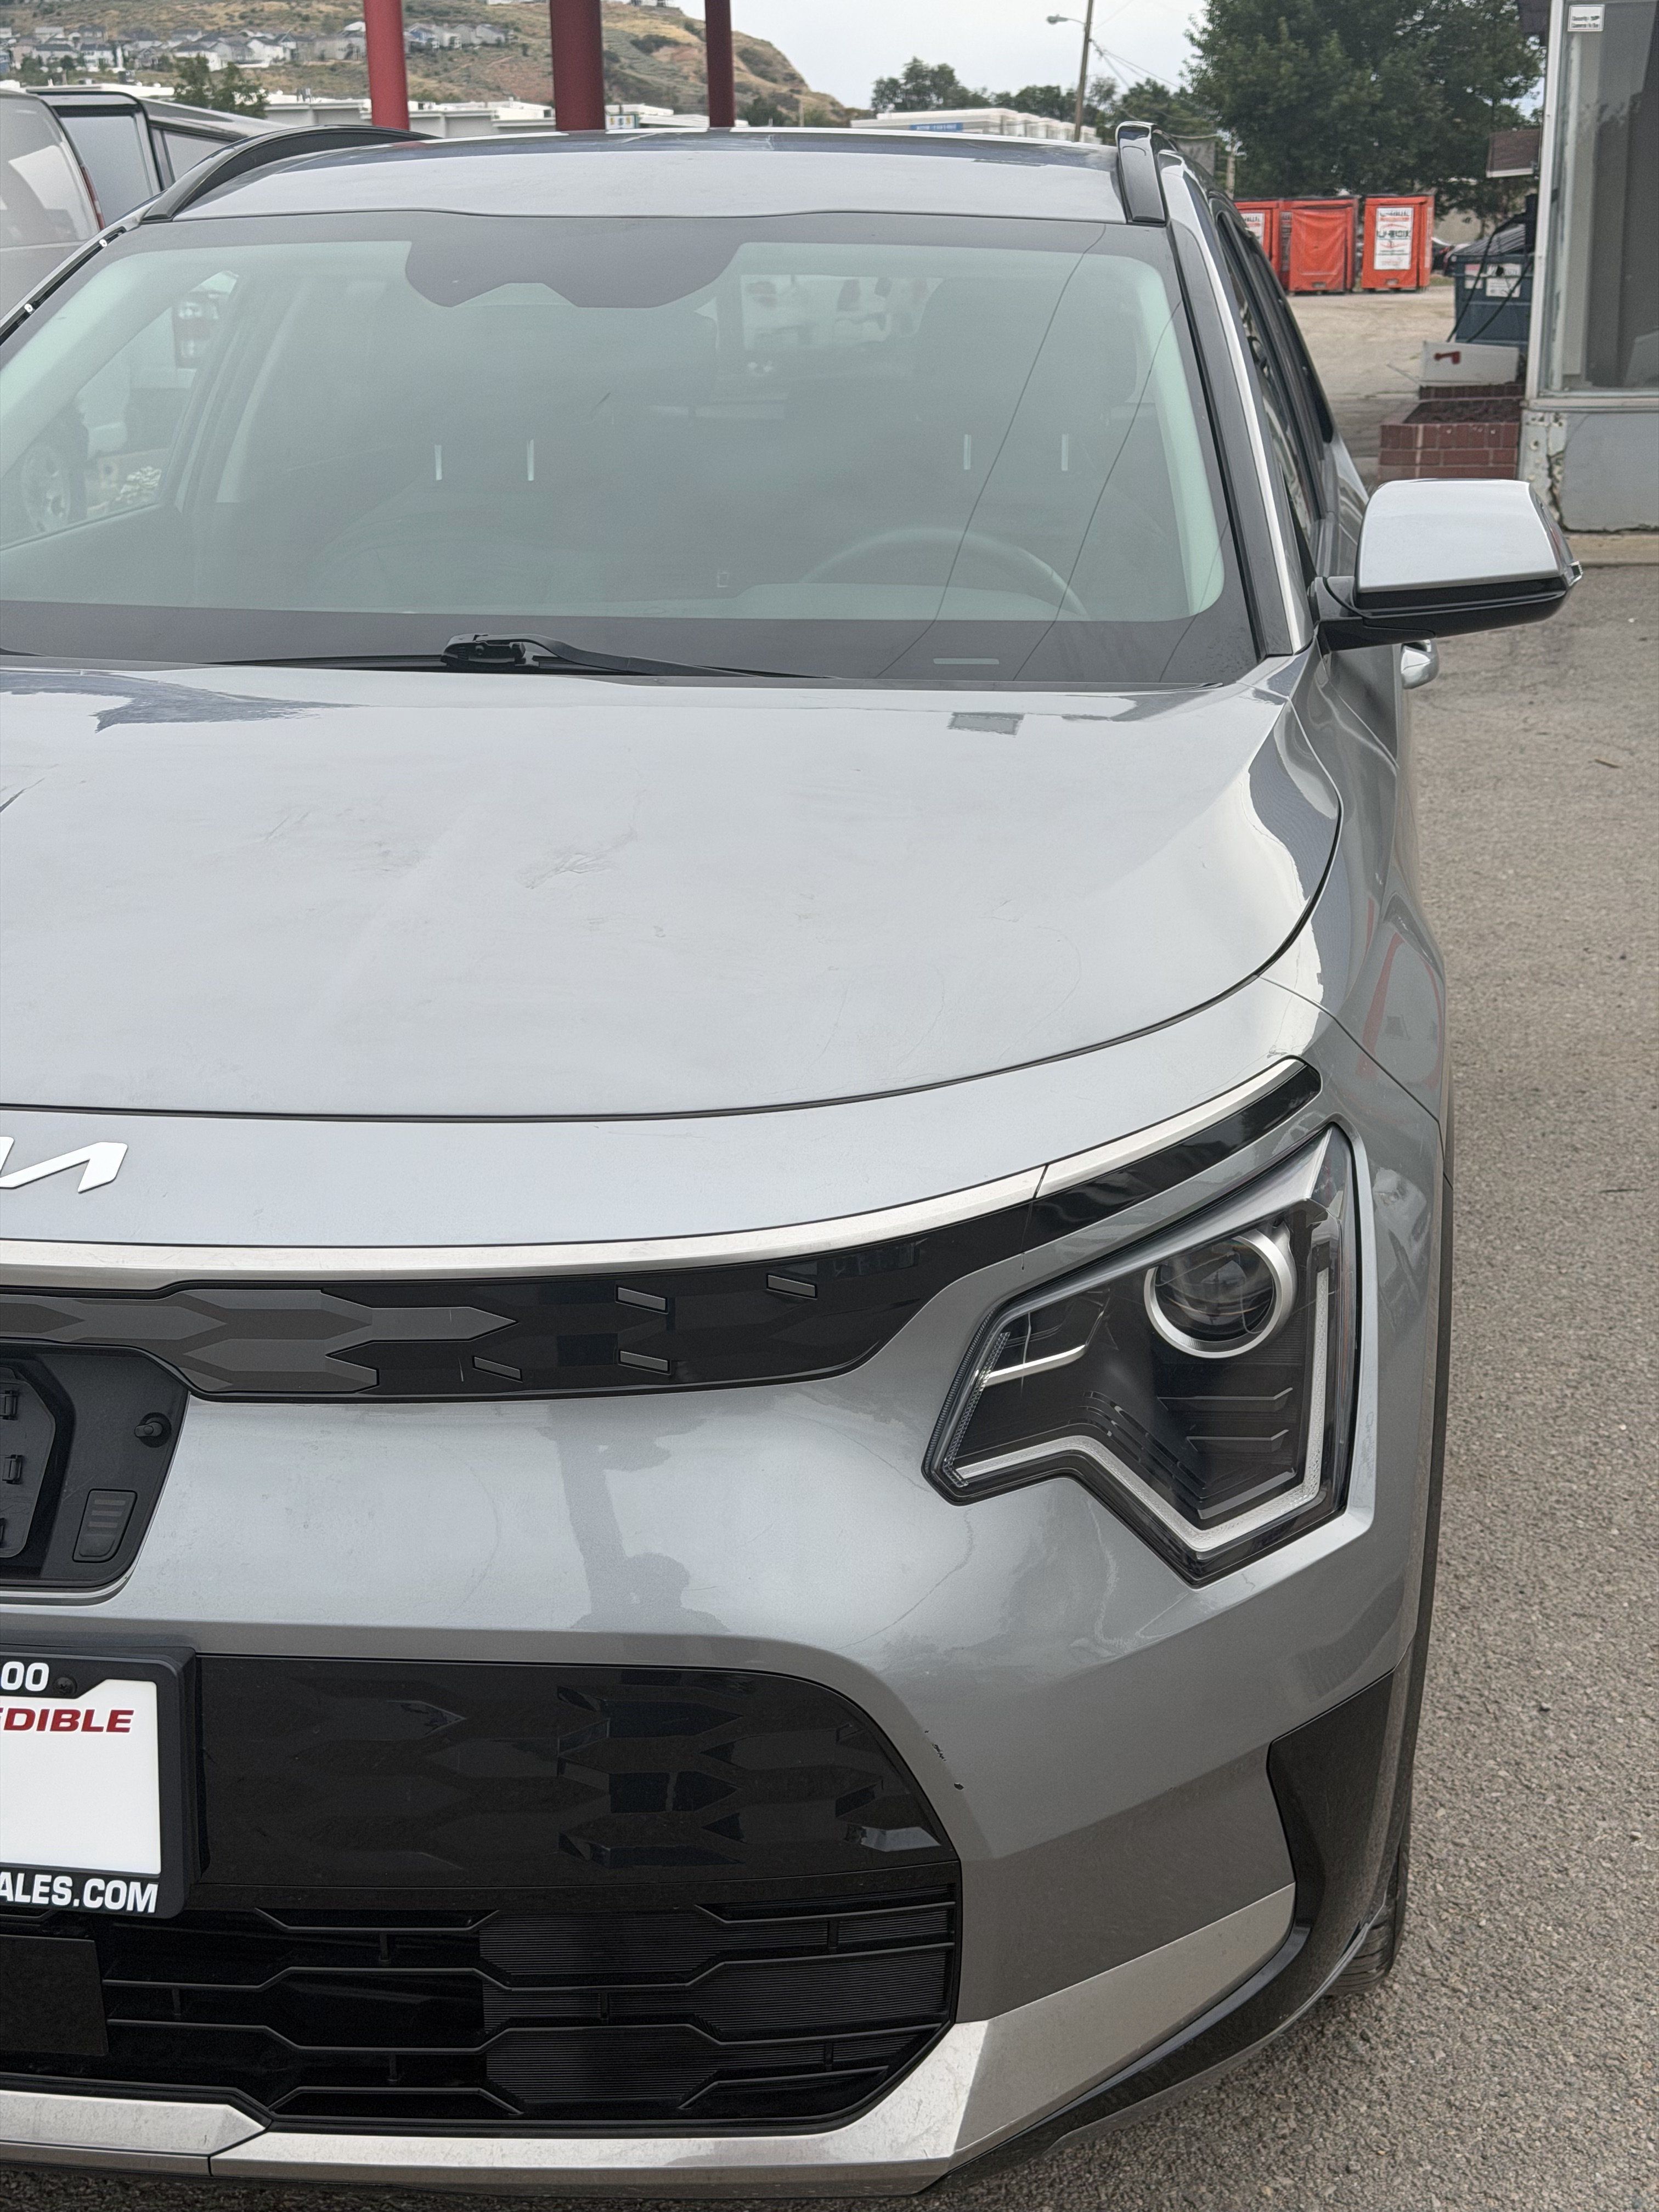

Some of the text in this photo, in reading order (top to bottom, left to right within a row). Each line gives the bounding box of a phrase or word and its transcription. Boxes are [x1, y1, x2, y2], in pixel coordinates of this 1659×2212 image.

[1, 1661, 49, 1691] 00
[0, 1707, 134, 1733] DIBLE
[0, 1871, 159, 1914] ALES.COM
